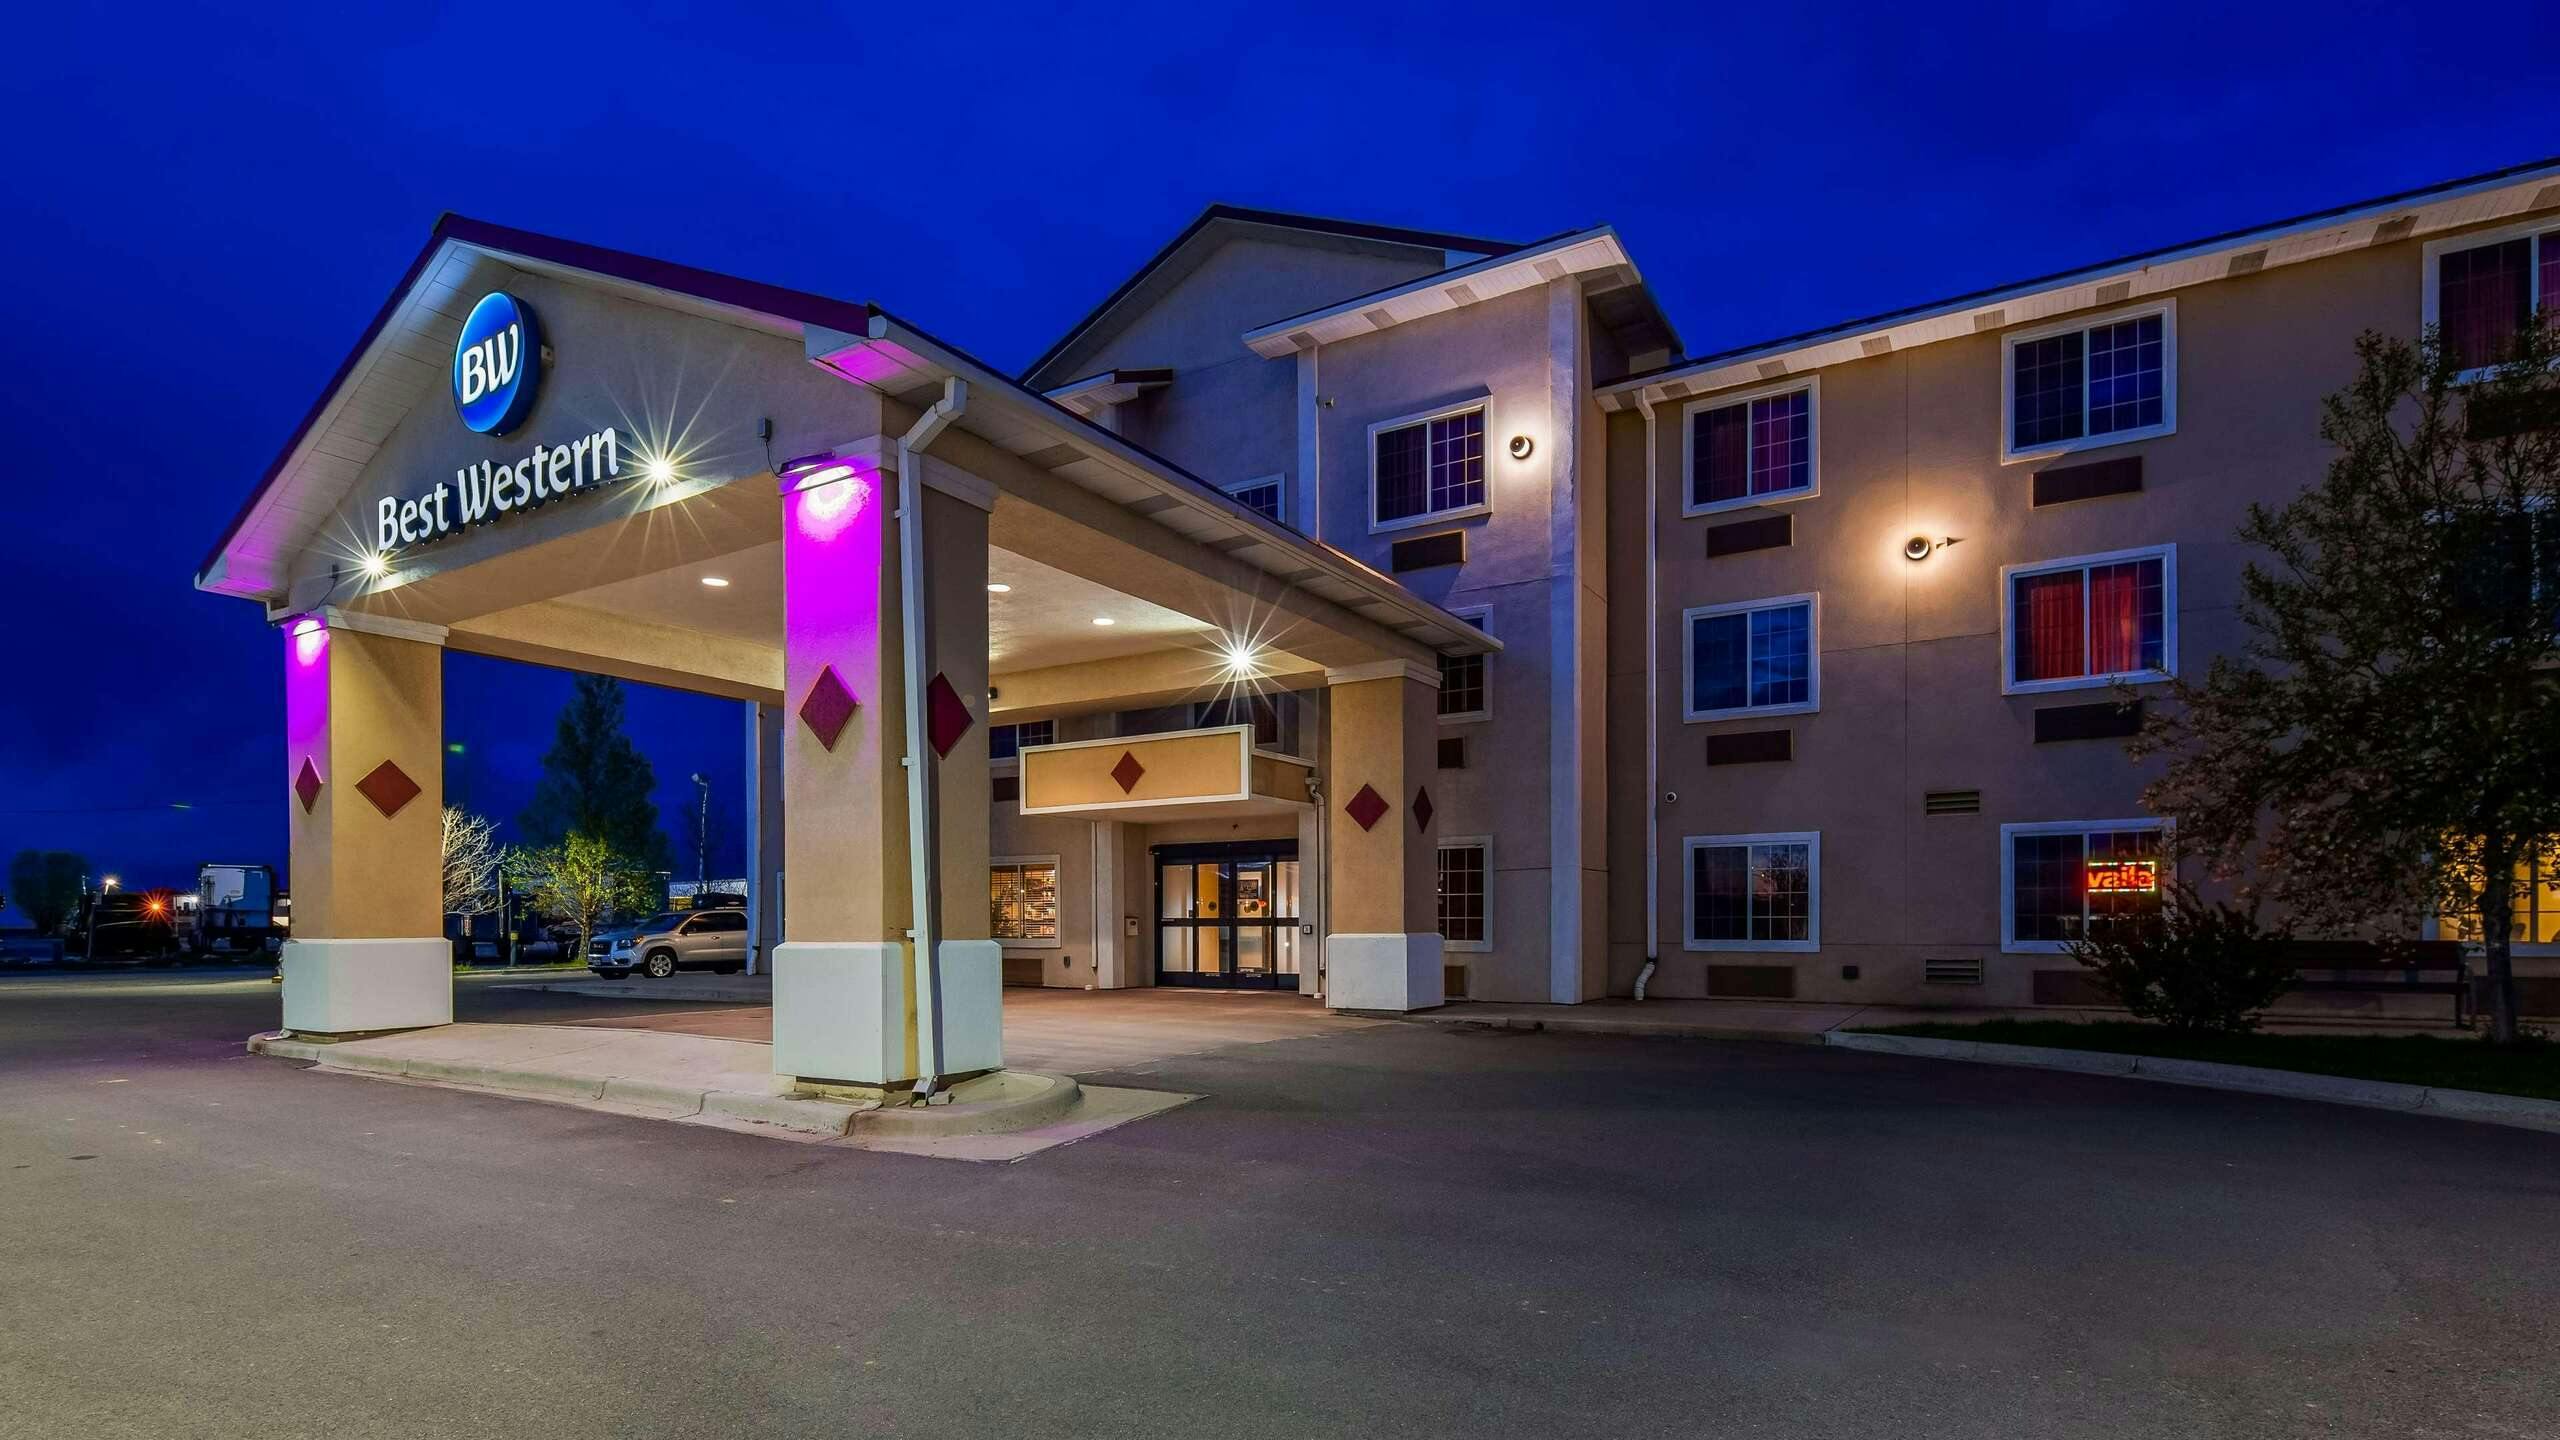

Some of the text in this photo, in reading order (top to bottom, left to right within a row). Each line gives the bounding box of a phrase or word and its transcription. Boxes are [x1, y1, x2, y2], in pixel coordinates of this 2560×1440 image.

[461, 323, 519, 405] BW
[378, 426, 620, 550] Best Western
